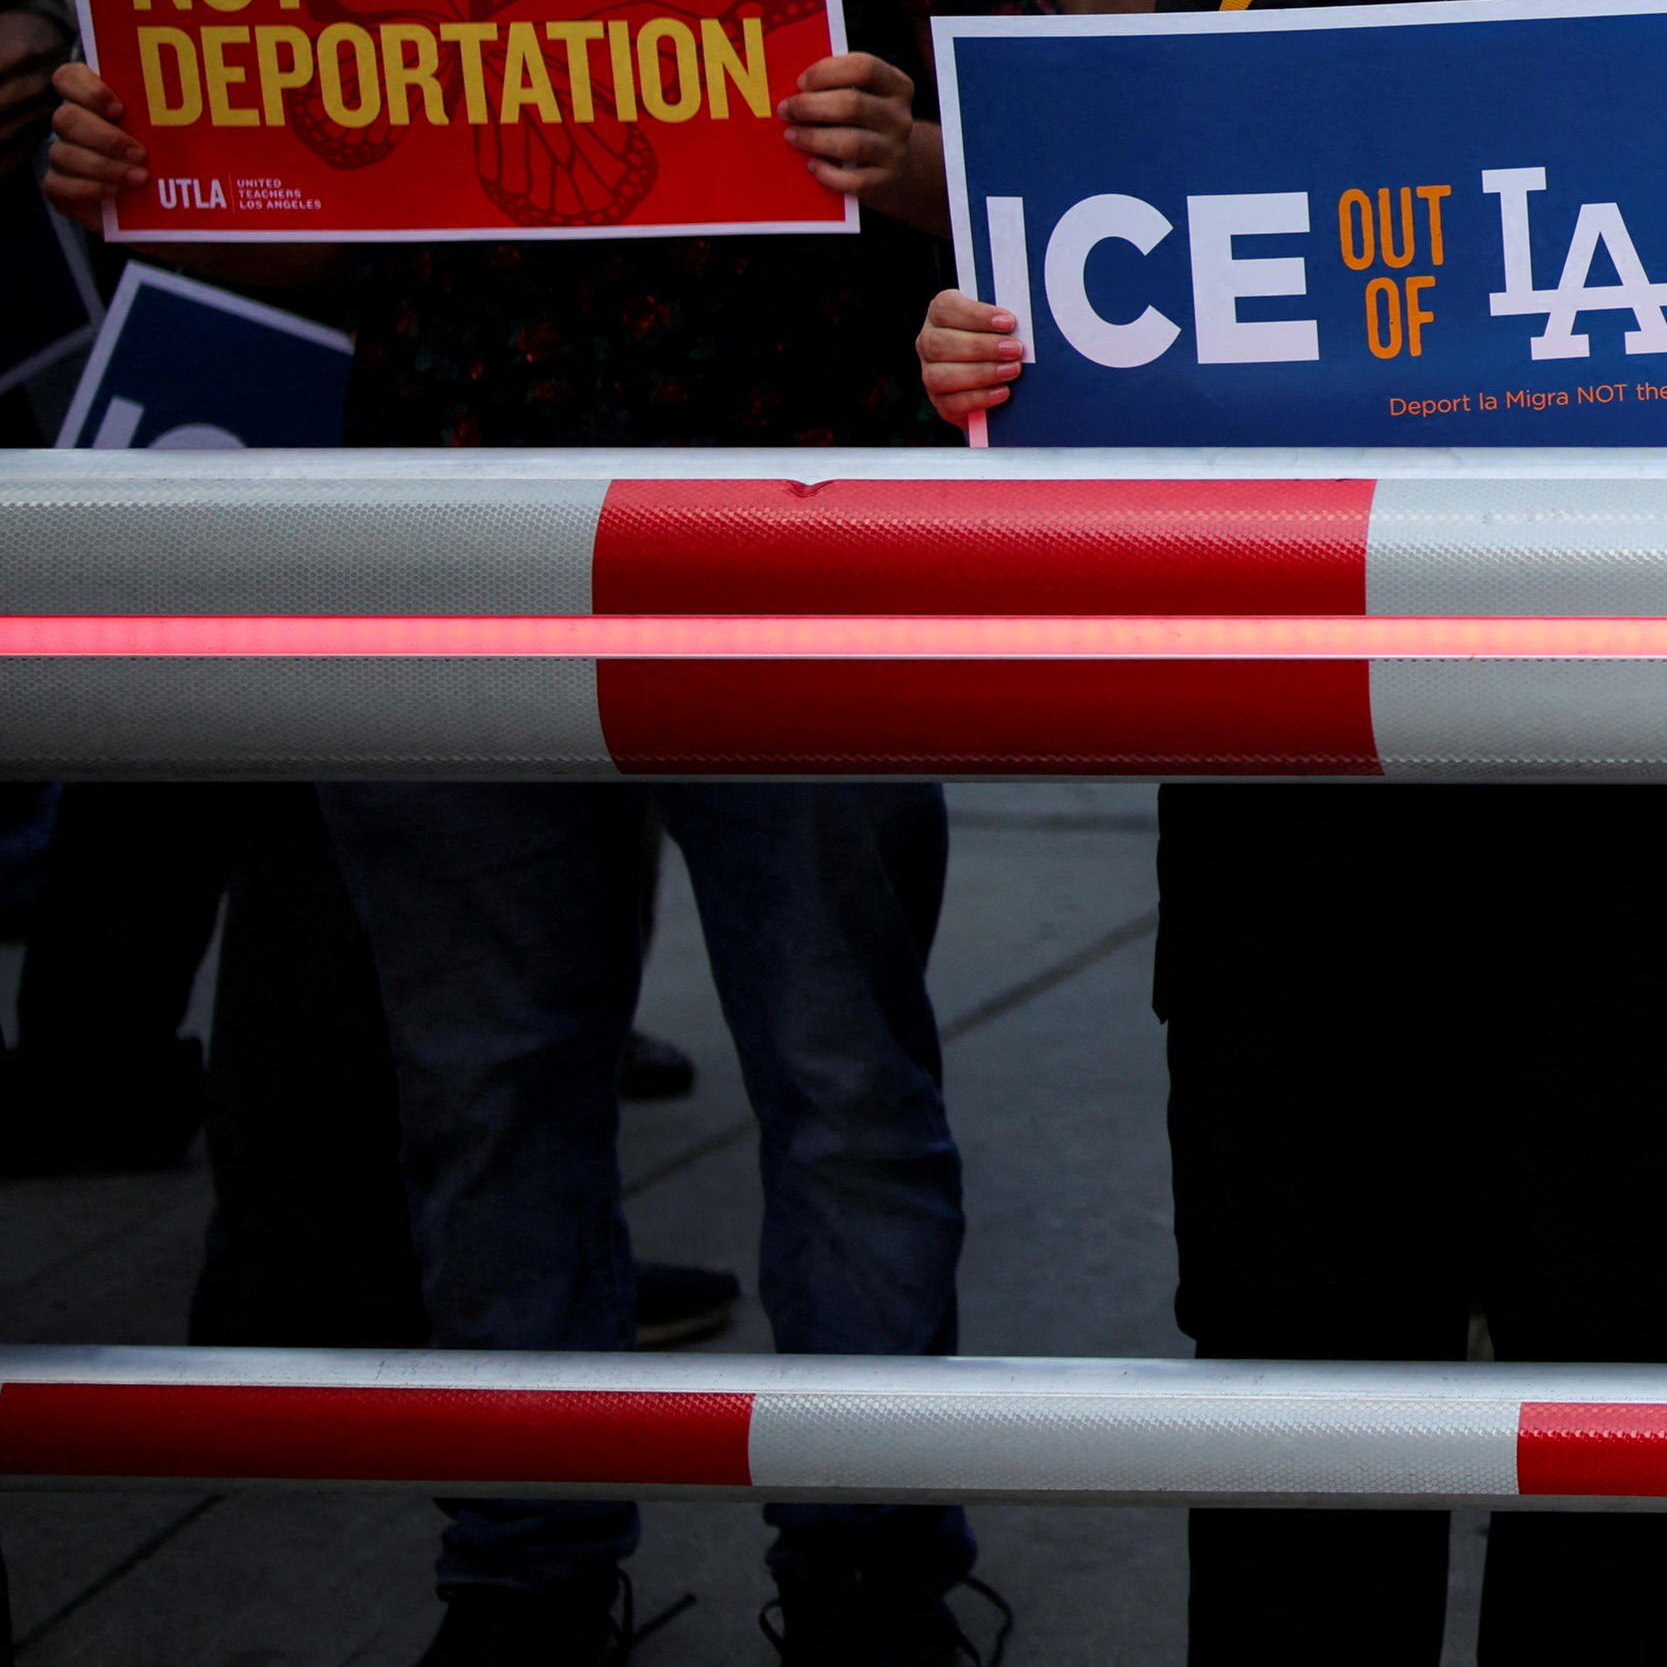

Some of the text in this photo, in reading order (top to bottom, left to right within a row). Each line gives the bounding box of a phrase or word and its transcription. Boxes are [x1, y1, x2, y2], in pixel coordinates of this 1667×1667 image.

[136, 17, 772, 128] DEPORTATION
[157, 178, 228, 210] UTLA
[236, 178, 282, 189] UNITED
[238, 189, 301, 199] TEACHERS
[239, 199, 322, 210] LOS ANGELES
[1337, 184, 1454, 272] OUT
[986, 192, 1321, 369] ICE
[1364, 274, 1438, 361] OF
[1389, 396, 1472, 418] Deport
[1478, 392, 1499, 411] la
[1505, 389, 1570, 412] Migra
[1576, 383, 1629, 405] NOT
